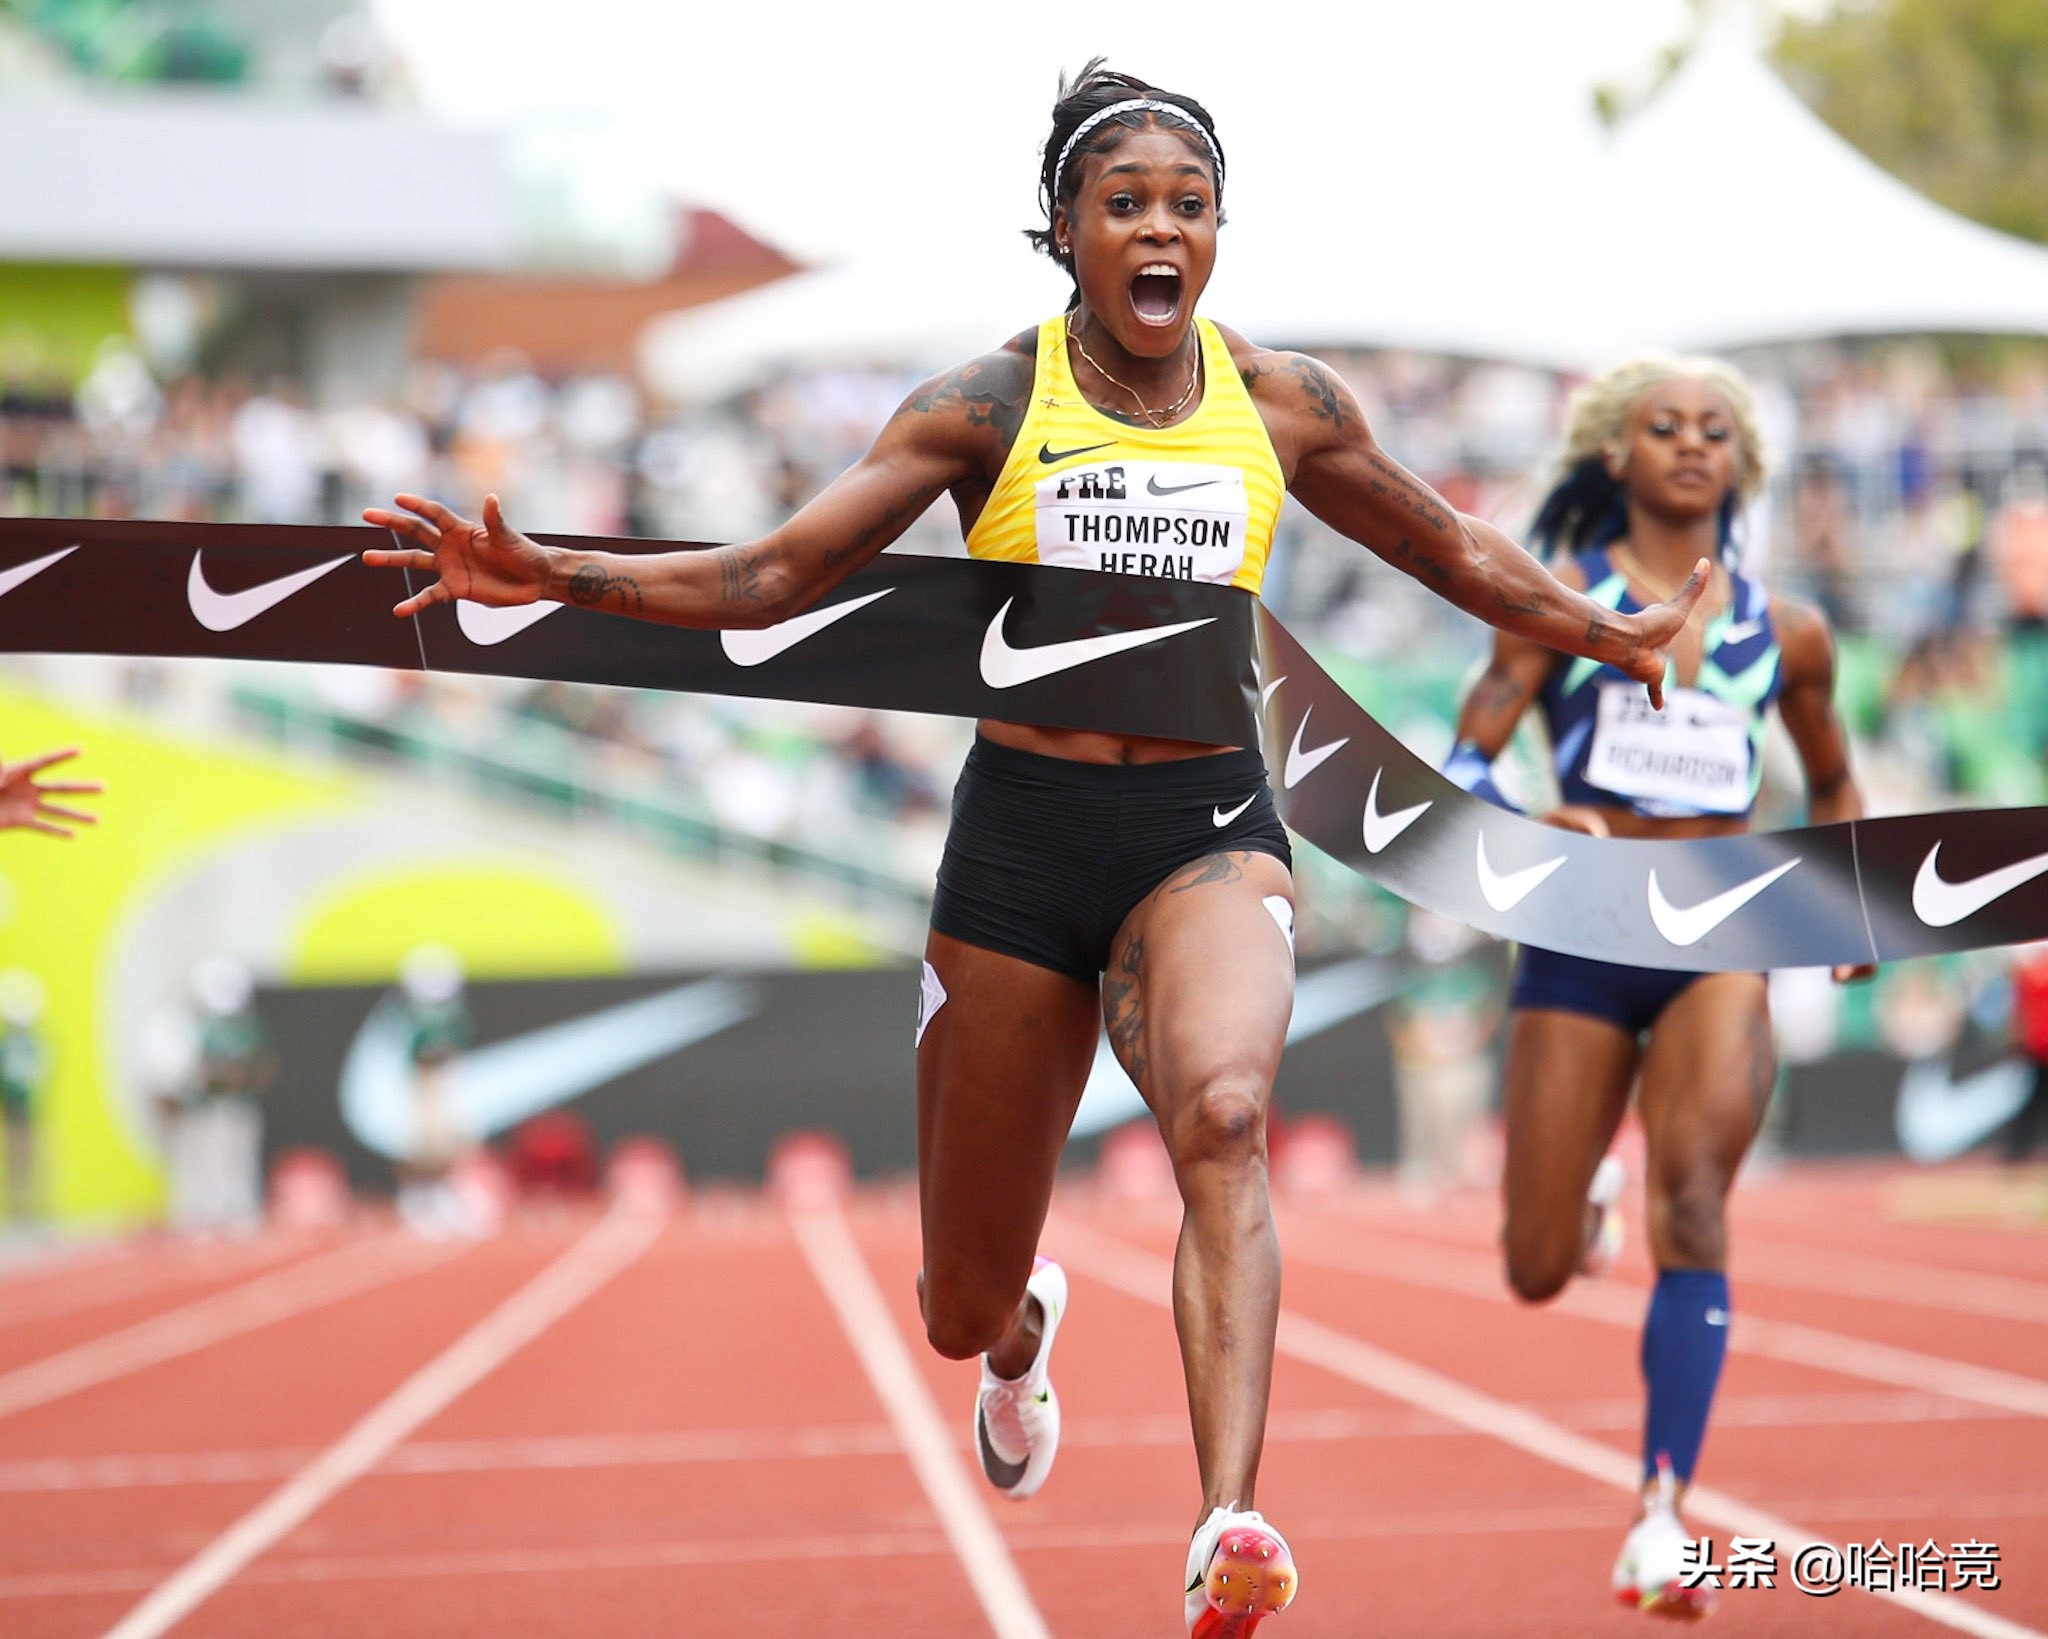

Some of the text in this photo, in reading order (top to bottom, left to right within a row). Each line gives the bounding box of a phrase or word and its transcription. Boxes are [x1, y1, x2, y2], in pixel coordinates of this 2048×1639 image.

[1057, 467, 1126, 499] PRE
[1064, 514, 1230, 547] THOMPSON
[1100, 552, 1193, 580] HERAH
